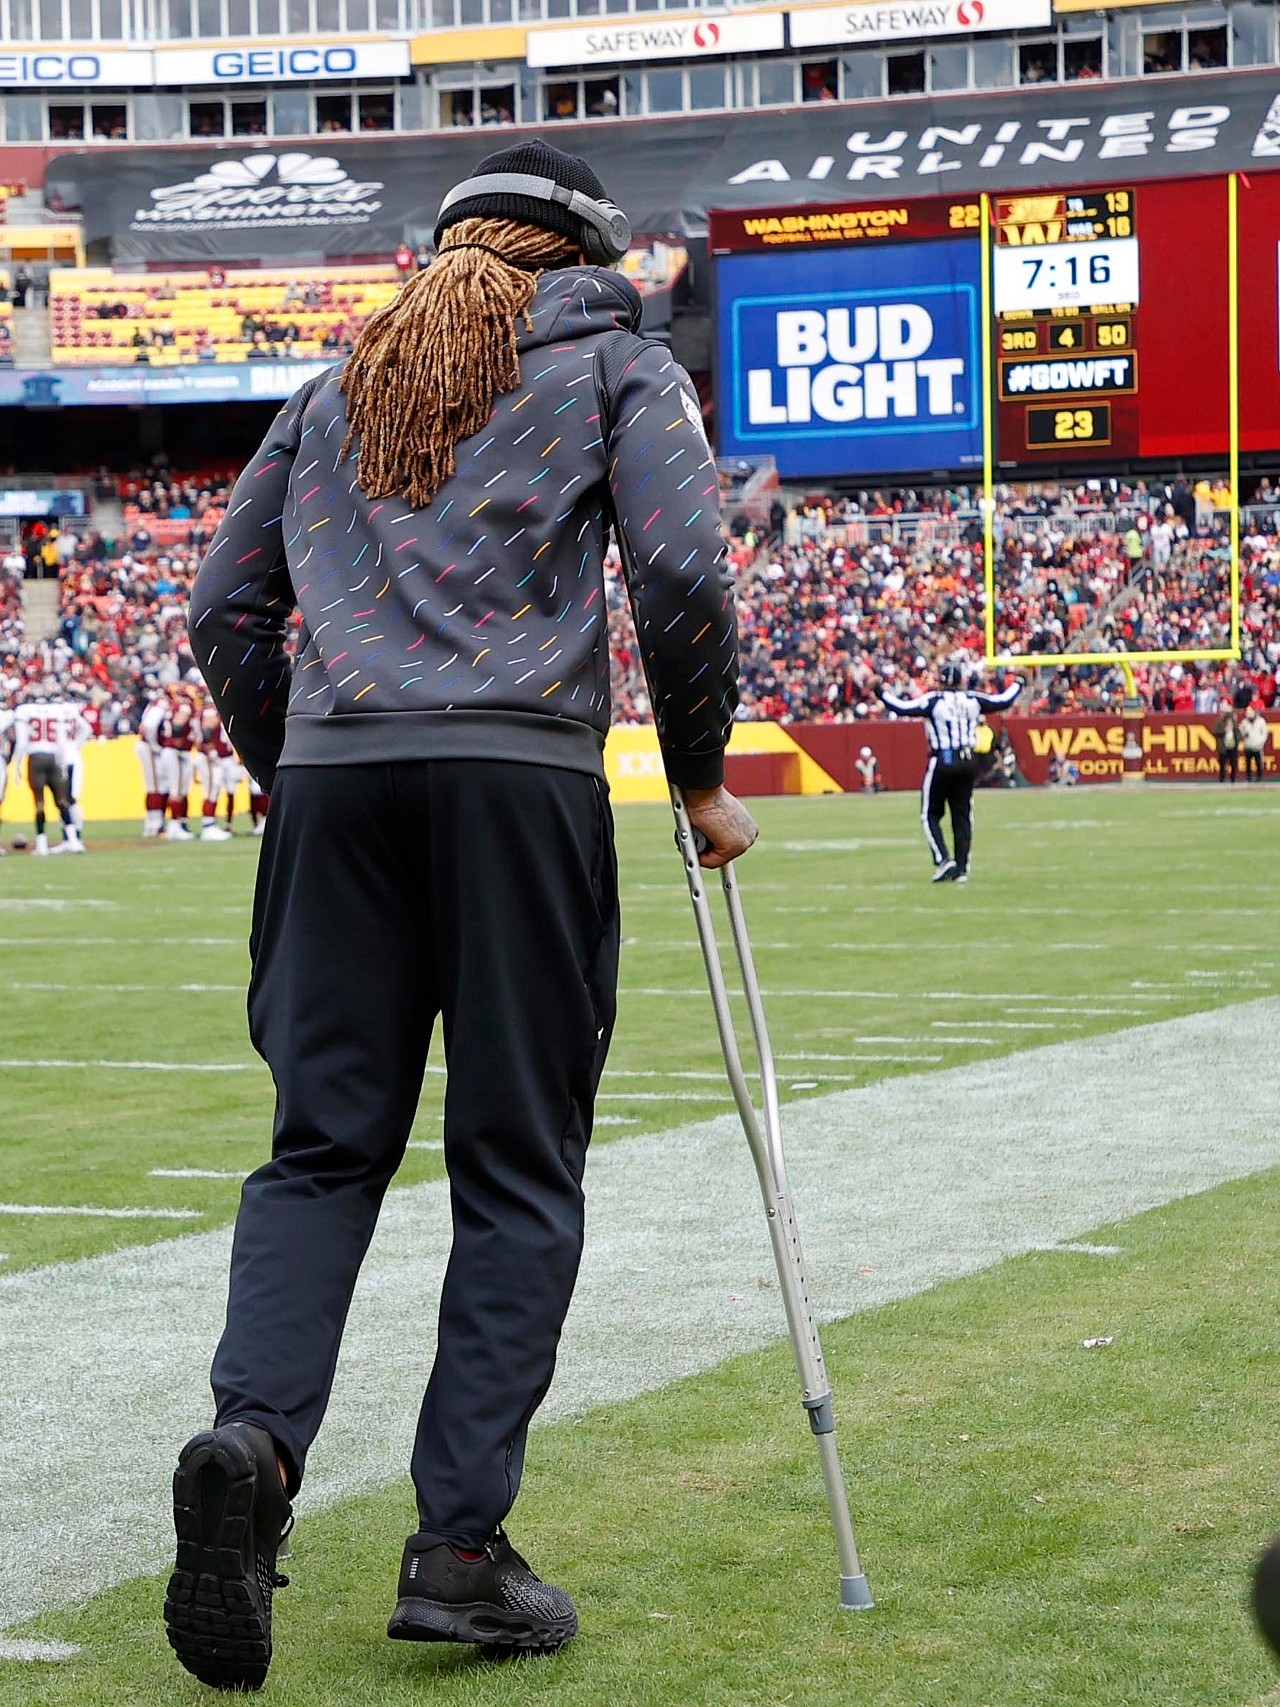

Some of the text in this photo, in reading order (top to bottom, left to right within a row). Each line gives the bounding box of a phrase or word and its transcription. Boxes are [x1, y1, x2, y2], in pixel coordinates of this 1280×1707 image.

[846, 5, 951, 34] SAFEWAY
[586, 27, 687, 55] SAFEWAY
[213, 47, 357, 77] GEICO
[846, 104, 1231, 155] UNITED
[726, 127, 1220, 186] AIRLINES
[1105, 191, 1129, 213] 13
[743, 208, 908, 236] WASHINGTON
[1022, 254, 1111, 290] 7:16
[776, 303, 934, 367] BUD
[1002, 331, 1037, 350] 3RD
[1058, 327, 1075, 348] 4
[1007, 358, 1129, 392] #GOWFT
[748, 357, 965, 425] LIGHT
[1054, 410, 1094, 439] 23
